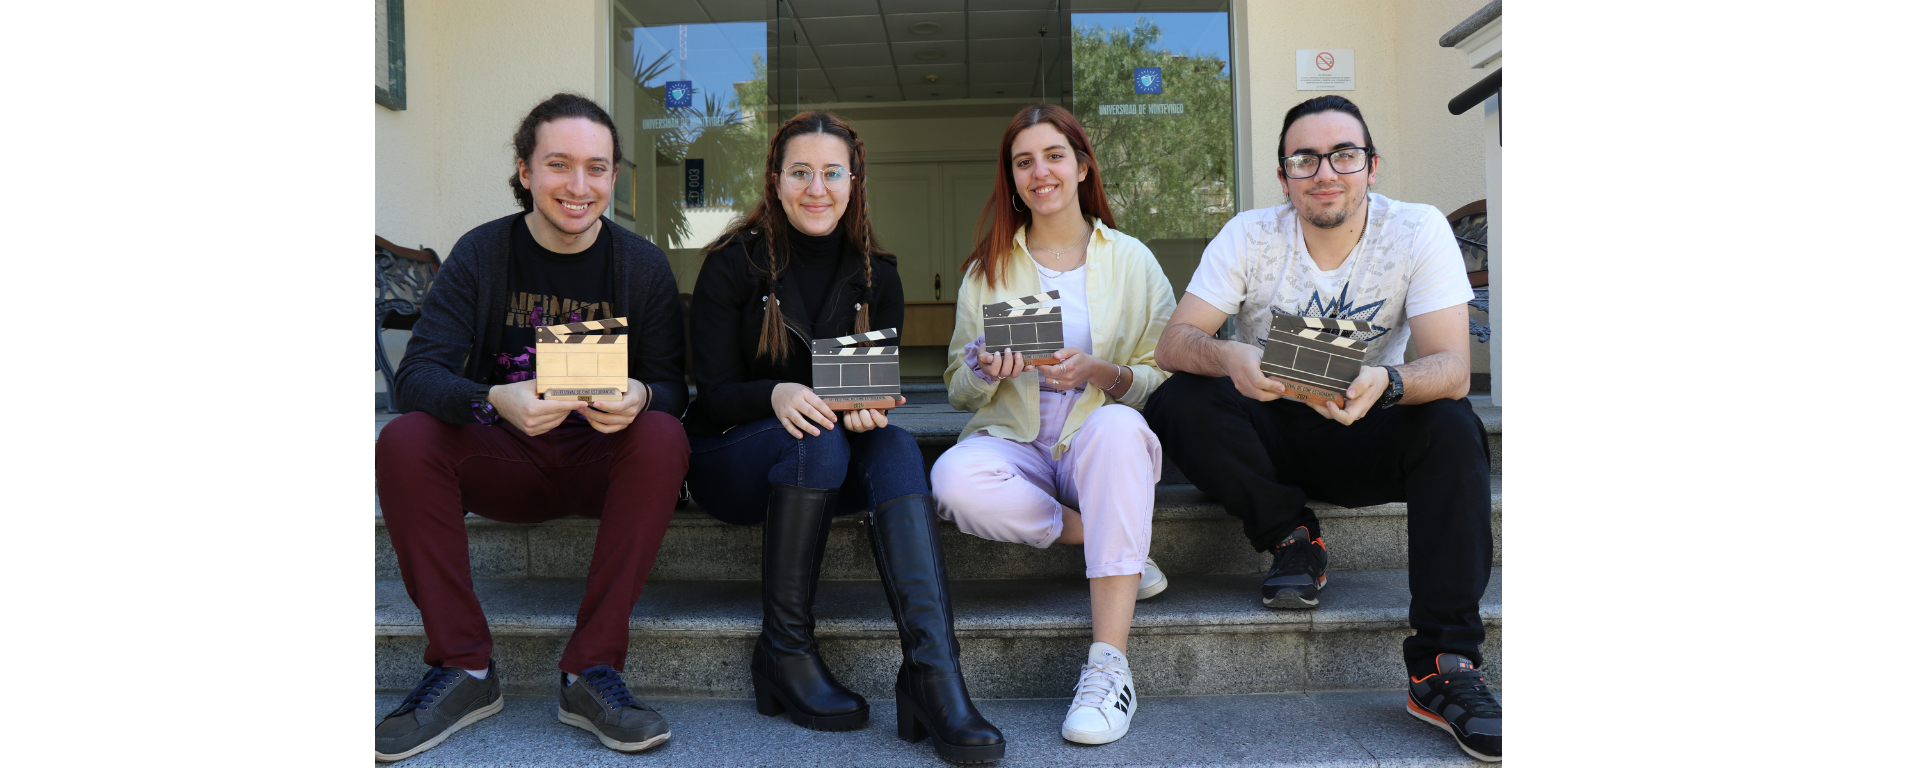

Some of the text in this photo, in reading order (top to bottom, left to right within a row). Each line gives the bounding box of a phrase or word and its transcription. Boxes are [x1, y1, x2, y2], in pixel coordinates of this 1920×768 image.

[1099, 103, 1184, 115] UNIVERSIDAD DE MONTEVIDEO
[642, 116, 724, 129] UNIVERSIDAD DE MONTEVIDEO
[689, 169, 699, 188] 003
